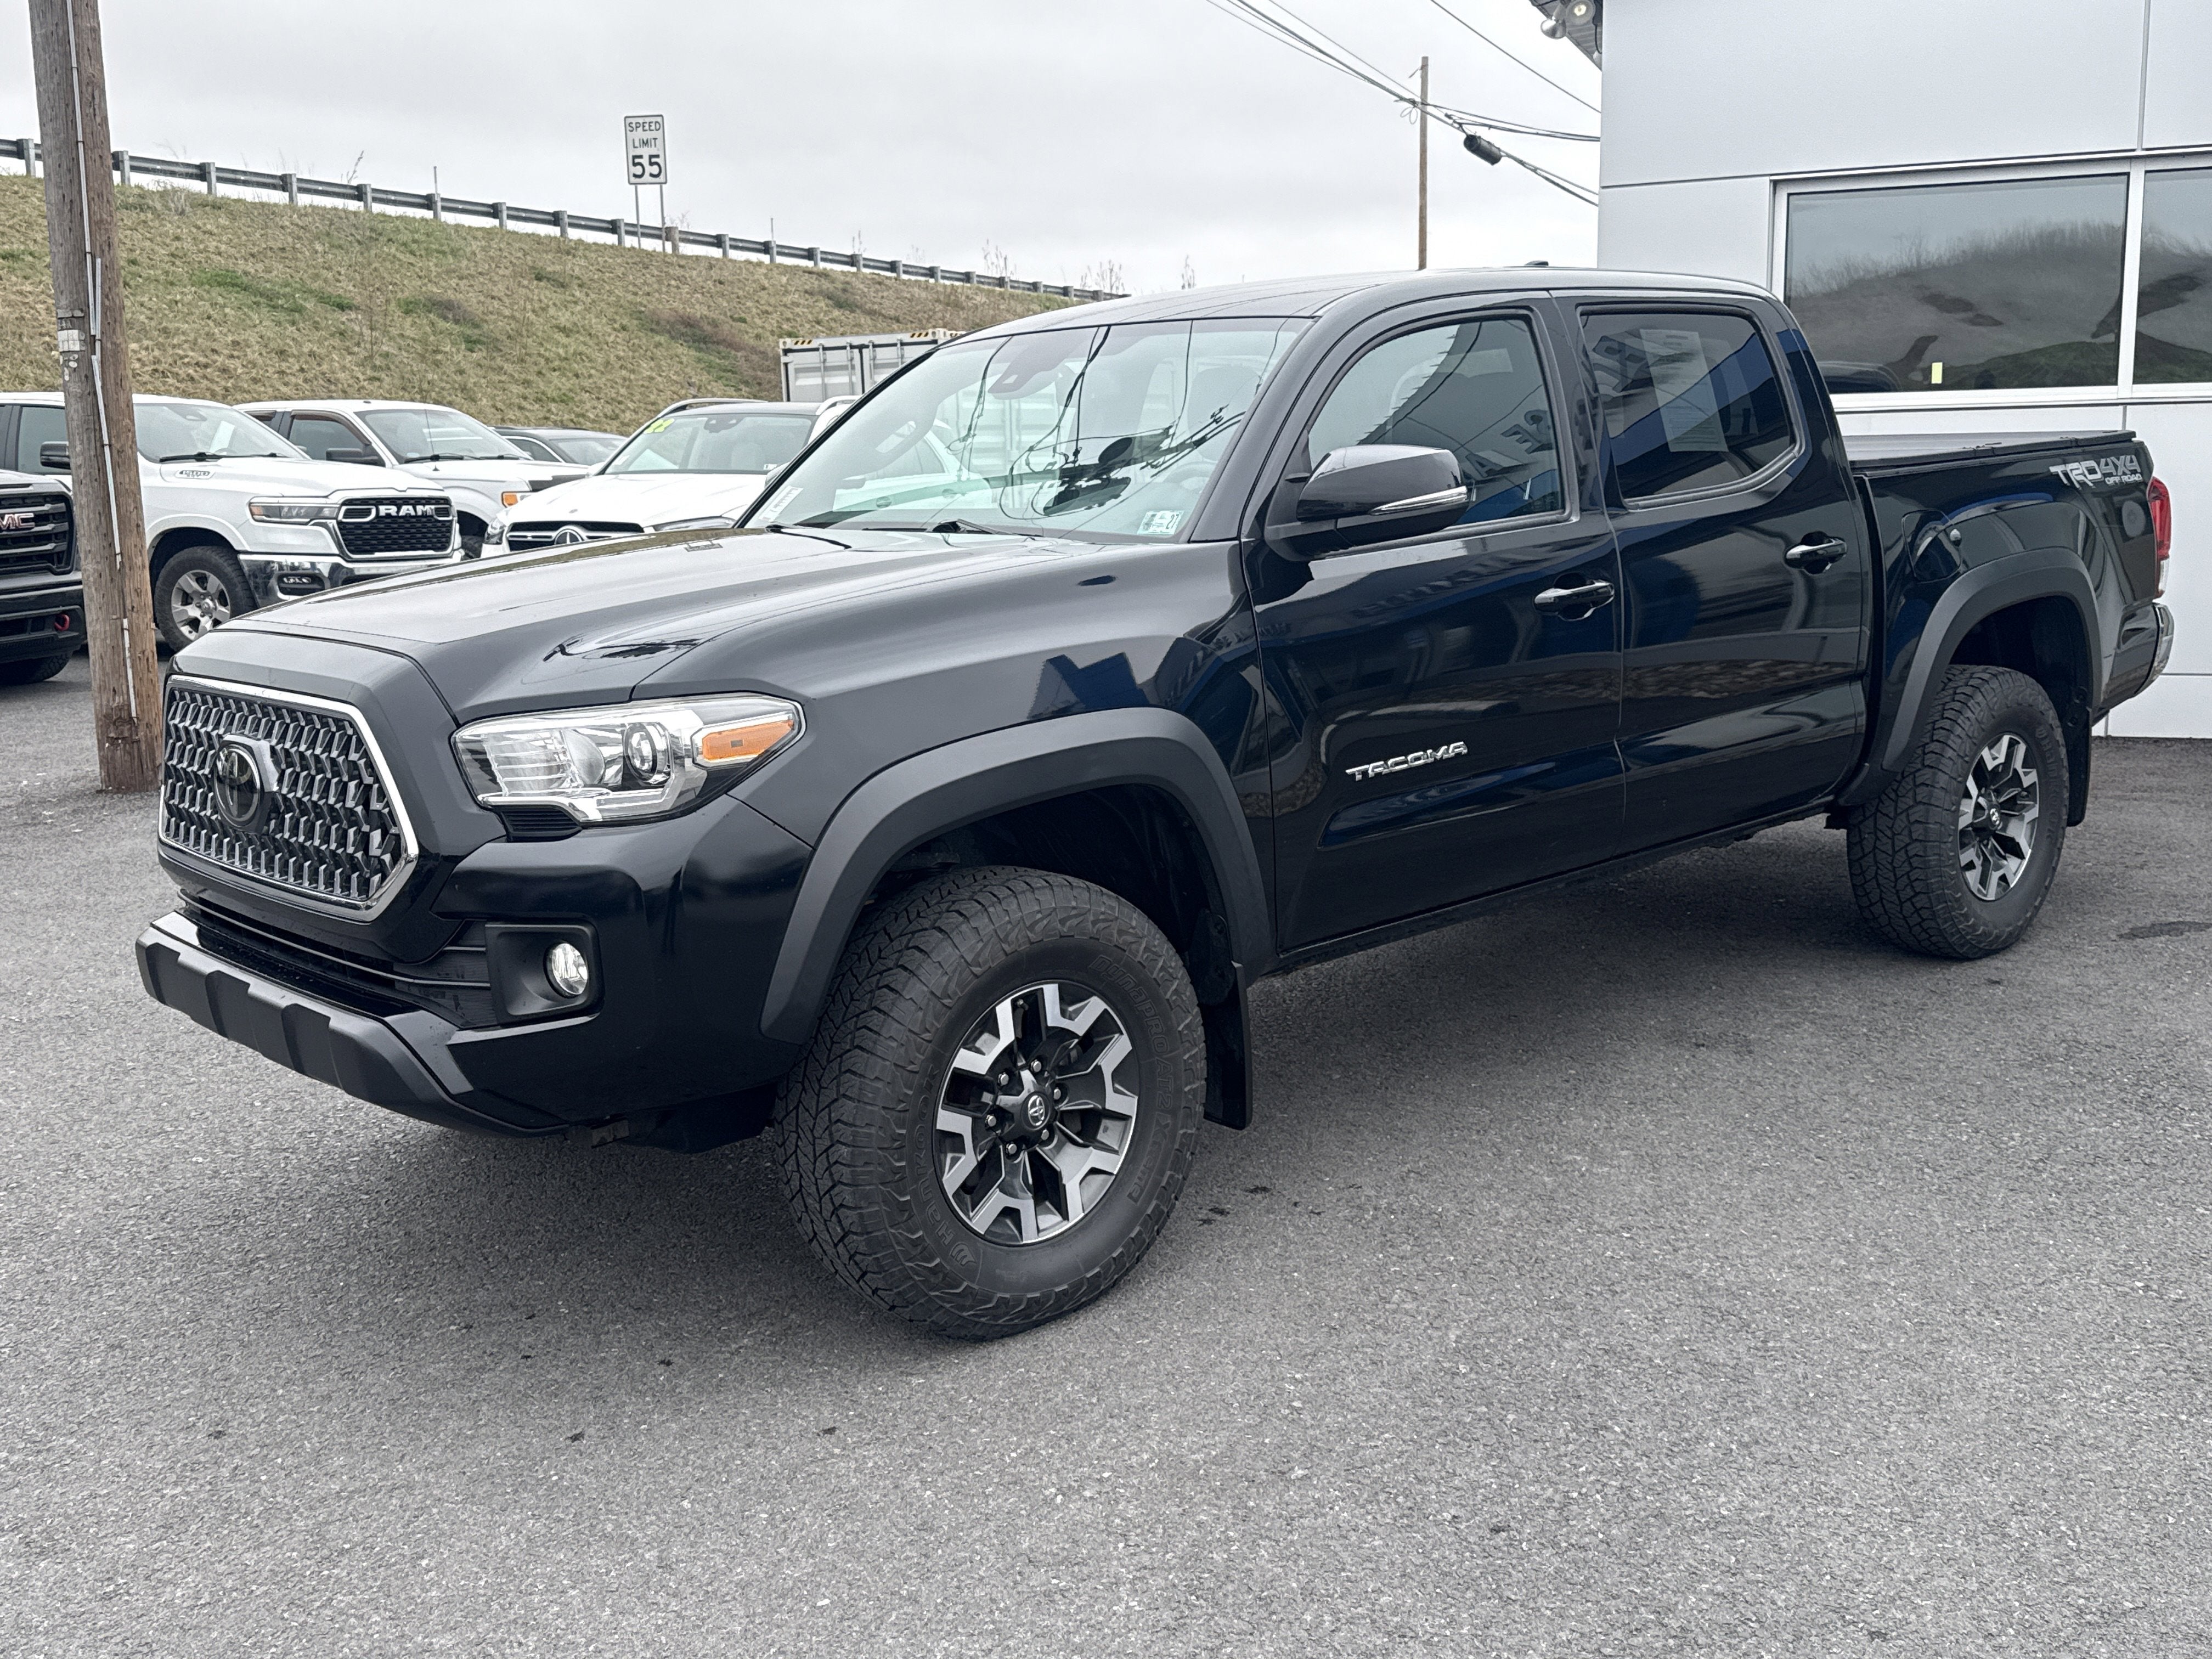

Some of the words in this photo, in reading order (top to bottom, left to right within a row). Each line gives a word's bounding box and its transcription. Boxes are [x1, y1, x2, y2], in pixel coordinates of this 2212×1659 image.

[628, 121, 661, 132] SPEED
[633, 138, 658, 149] LIMIT
[631, 154, 662, 178] 55
[2049, 460, 2103, 489] TRD
[2122, 474, 2142, 483] ROAD
[378, 505, 435, 516] RAM
[1345, 741, 1468, 781] TACOMA
